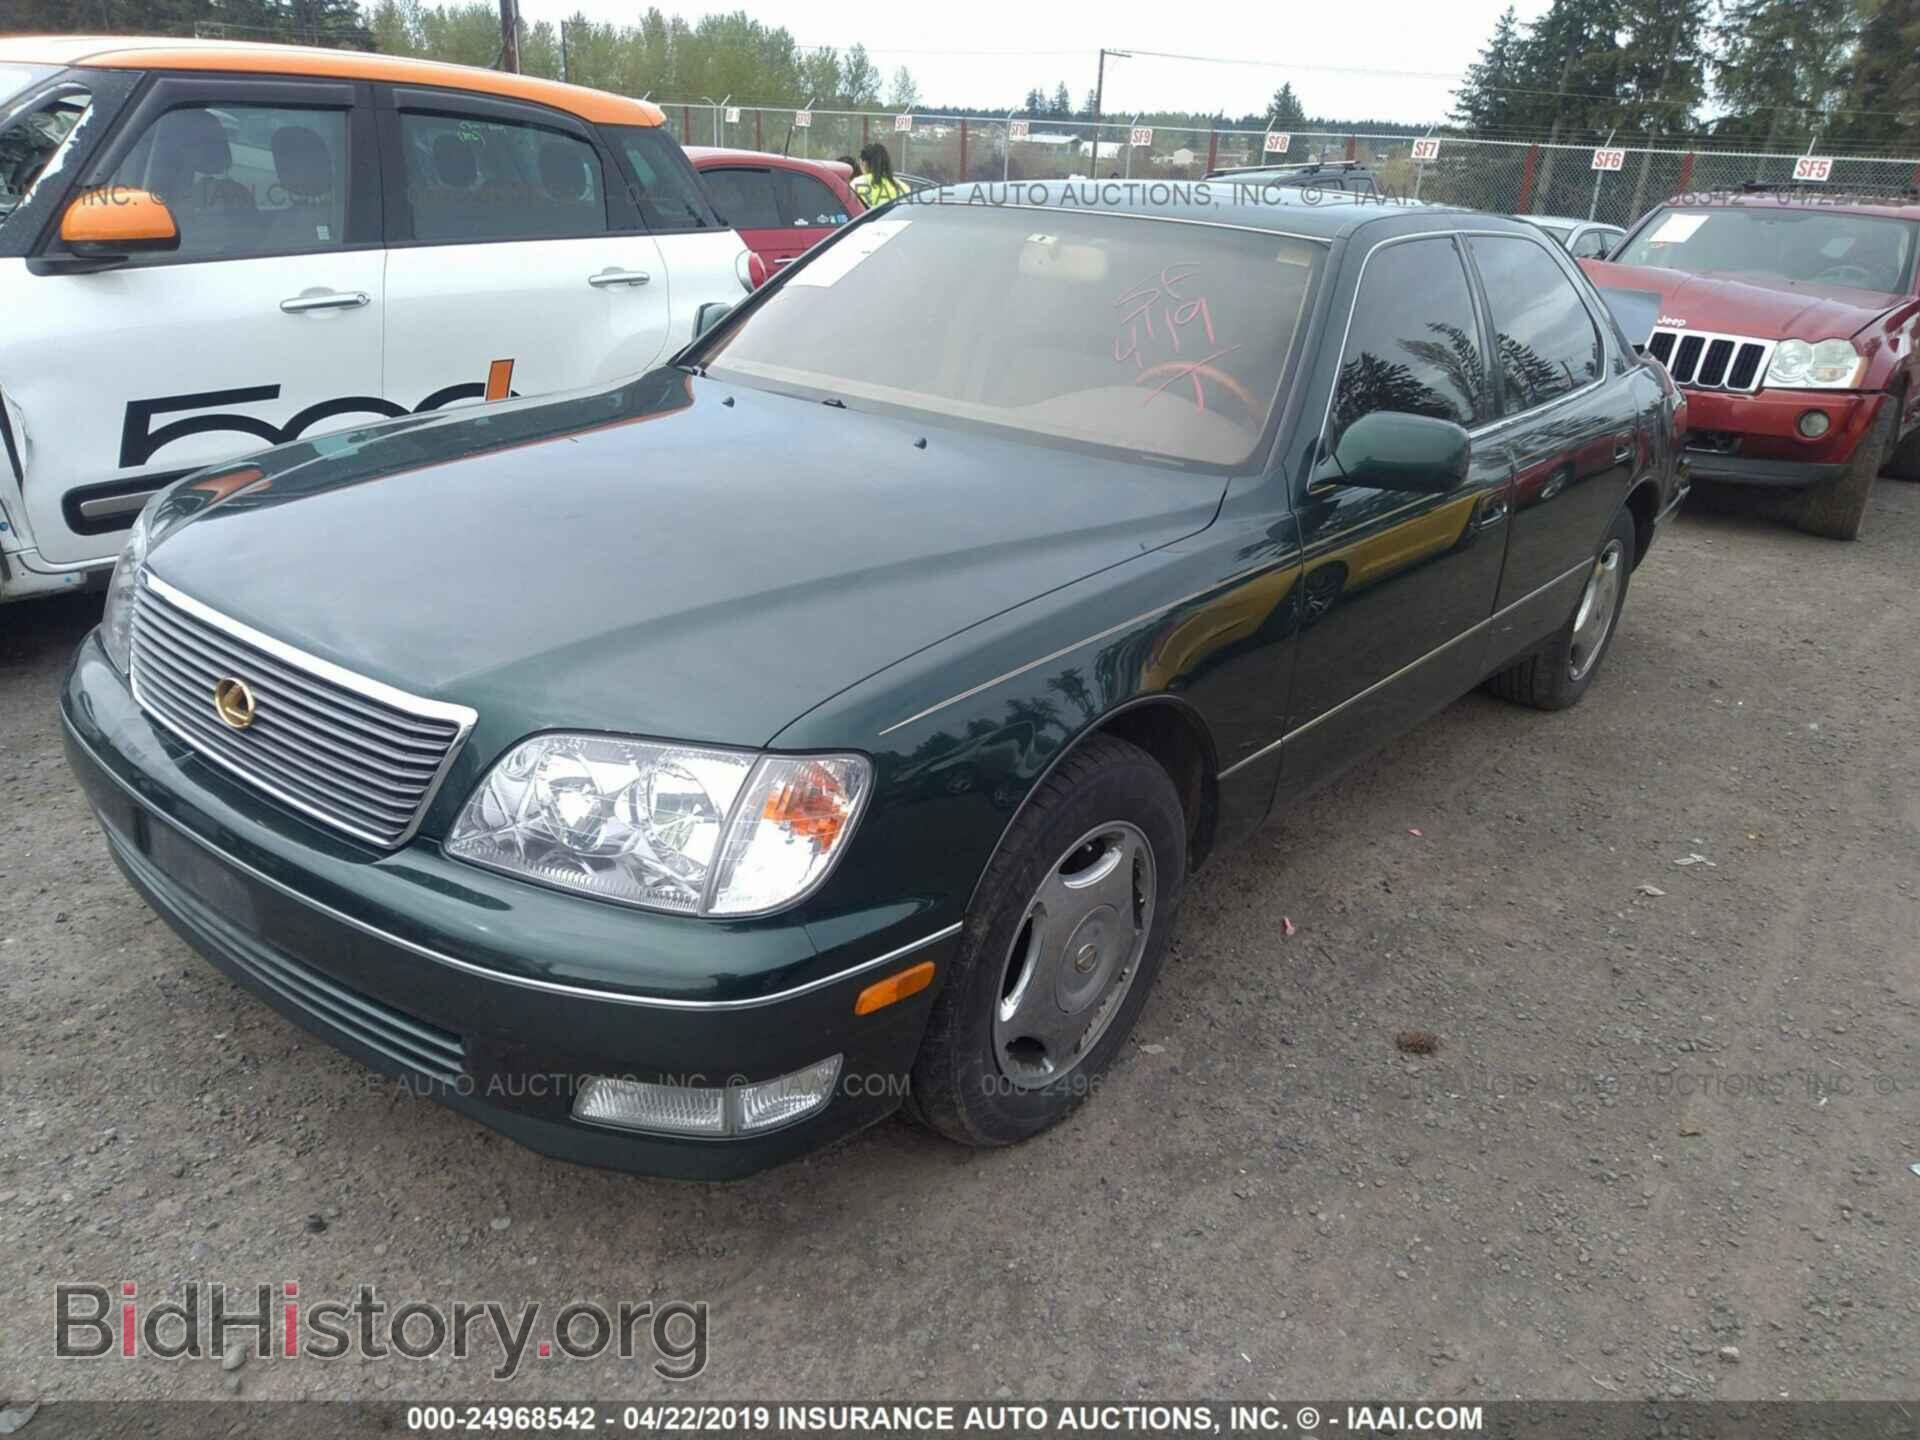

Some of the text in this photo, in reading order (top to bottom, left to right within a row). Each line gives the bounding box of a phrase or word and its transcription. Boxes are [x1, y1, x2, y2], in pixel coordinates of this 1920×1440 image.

[1132, 130, 1150, 143] SF9
[1267, 135, 1287, 149] SF8
[1414, 141, 1437, 156] SF7
[1595, 151, 1621, 167] SF6
[1797, 160, 1829, 177] SF5
[1656, 314, 1687, 329] Jeep
